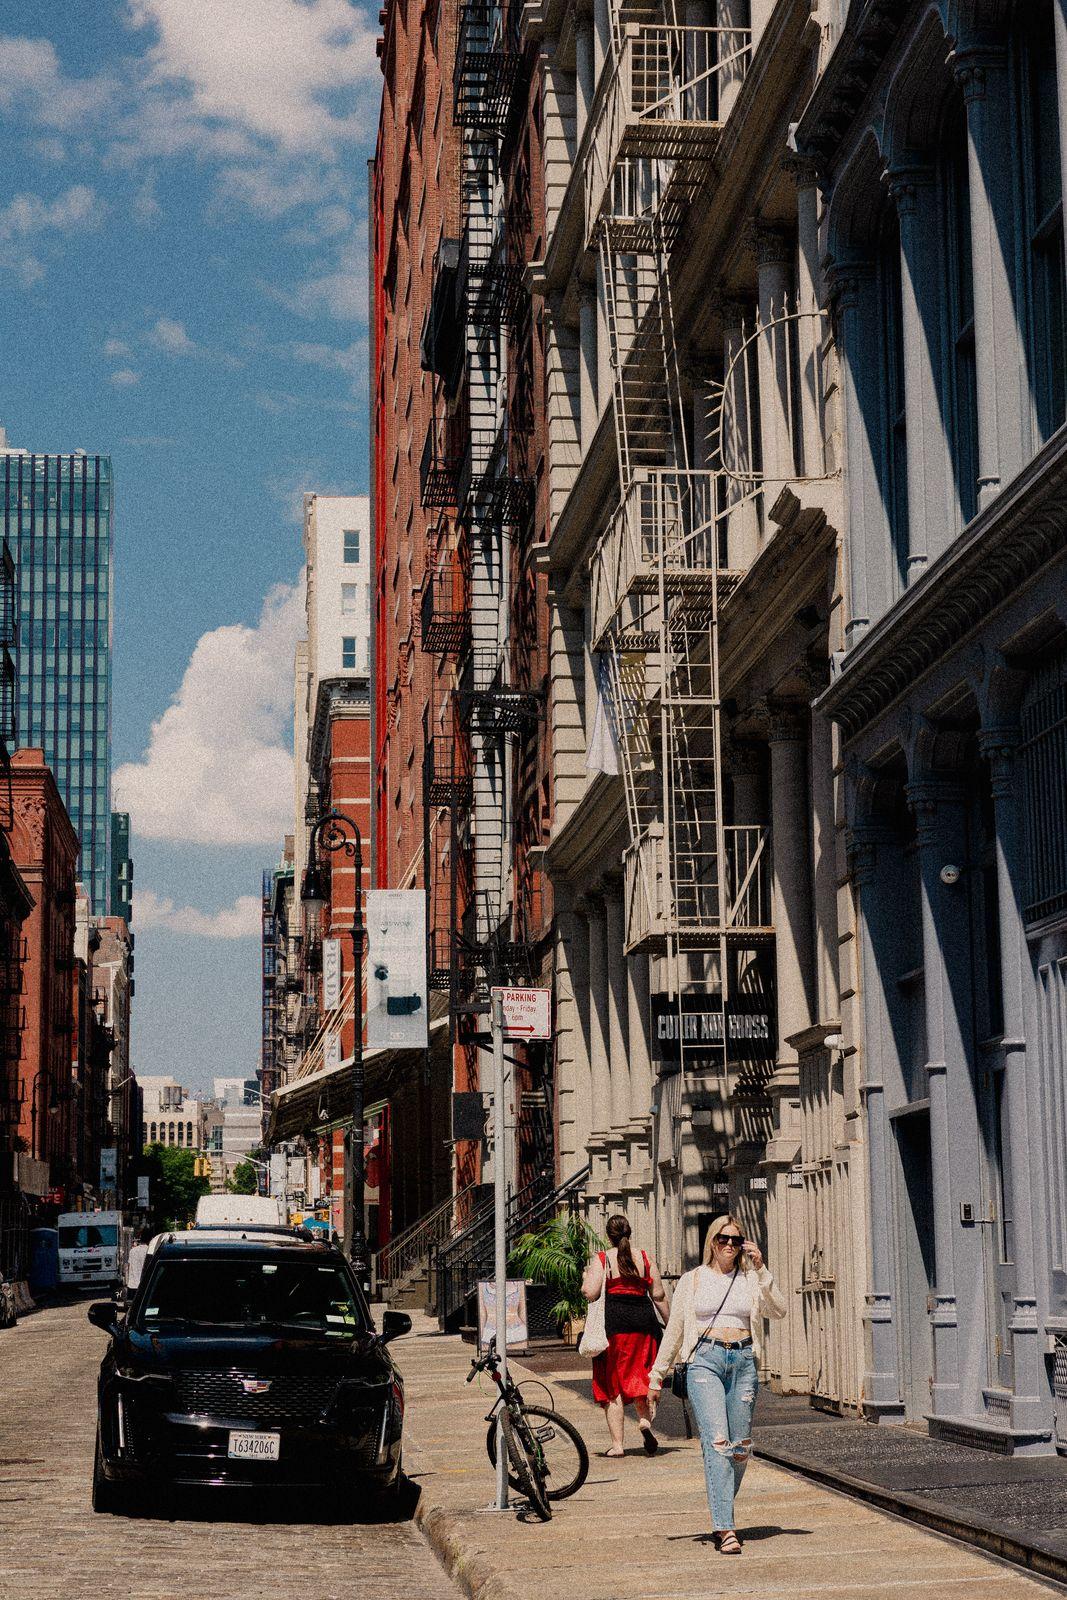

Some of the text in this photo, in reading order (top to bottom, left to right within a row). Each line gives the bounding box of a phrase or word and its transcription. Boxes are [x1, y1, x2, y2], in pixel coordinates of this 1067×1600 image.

[326, 940, 338, 1009] PRADA
[506, 992, 537, 1002] PARKING
[520, 1004, 537, 1013] Friday
[728, 1014, 769, 1039] GROSS
[233, 1439, 275, 1454] T634206C
